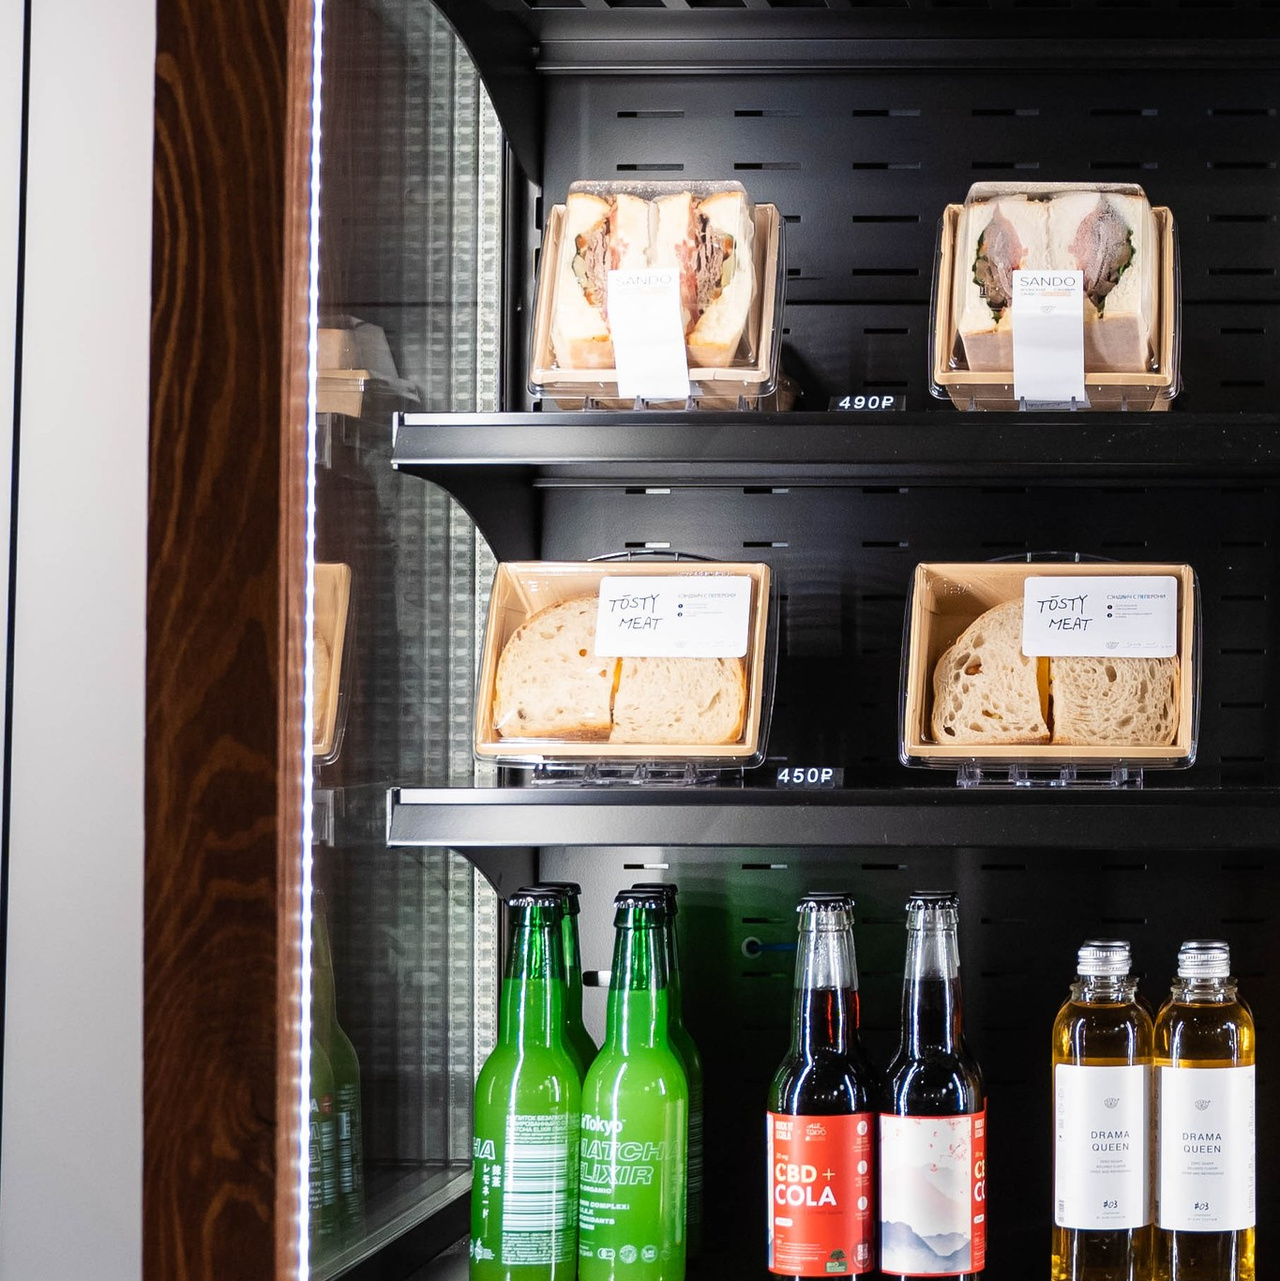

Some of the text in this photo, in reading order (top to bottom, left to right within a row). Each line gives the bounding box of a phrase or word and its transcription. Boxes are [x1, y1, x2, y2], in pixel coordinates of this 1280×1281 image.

[616, 274, 672, 287] SANDO
[1020, 276, 1076, 287] SANDO
[618, 617, 663, 631] MEAT
[1048, 618, 1093, 632] MEAT
[1091, 1131, 1130, 1139] DRAMA
[1182, 1132, 1222, 1141] DRAMA
[1092, 1143, 1129, 1152] QUEEN
[1183, 1145, 1221, 1153] QUEEN
[775, 1163, 817, 1183] CBD
[775, 1184, 837, 1206] COLA
[1103, 1200, 1118, 1209] #03
[1194, 1202, 1209, 1210] #03
